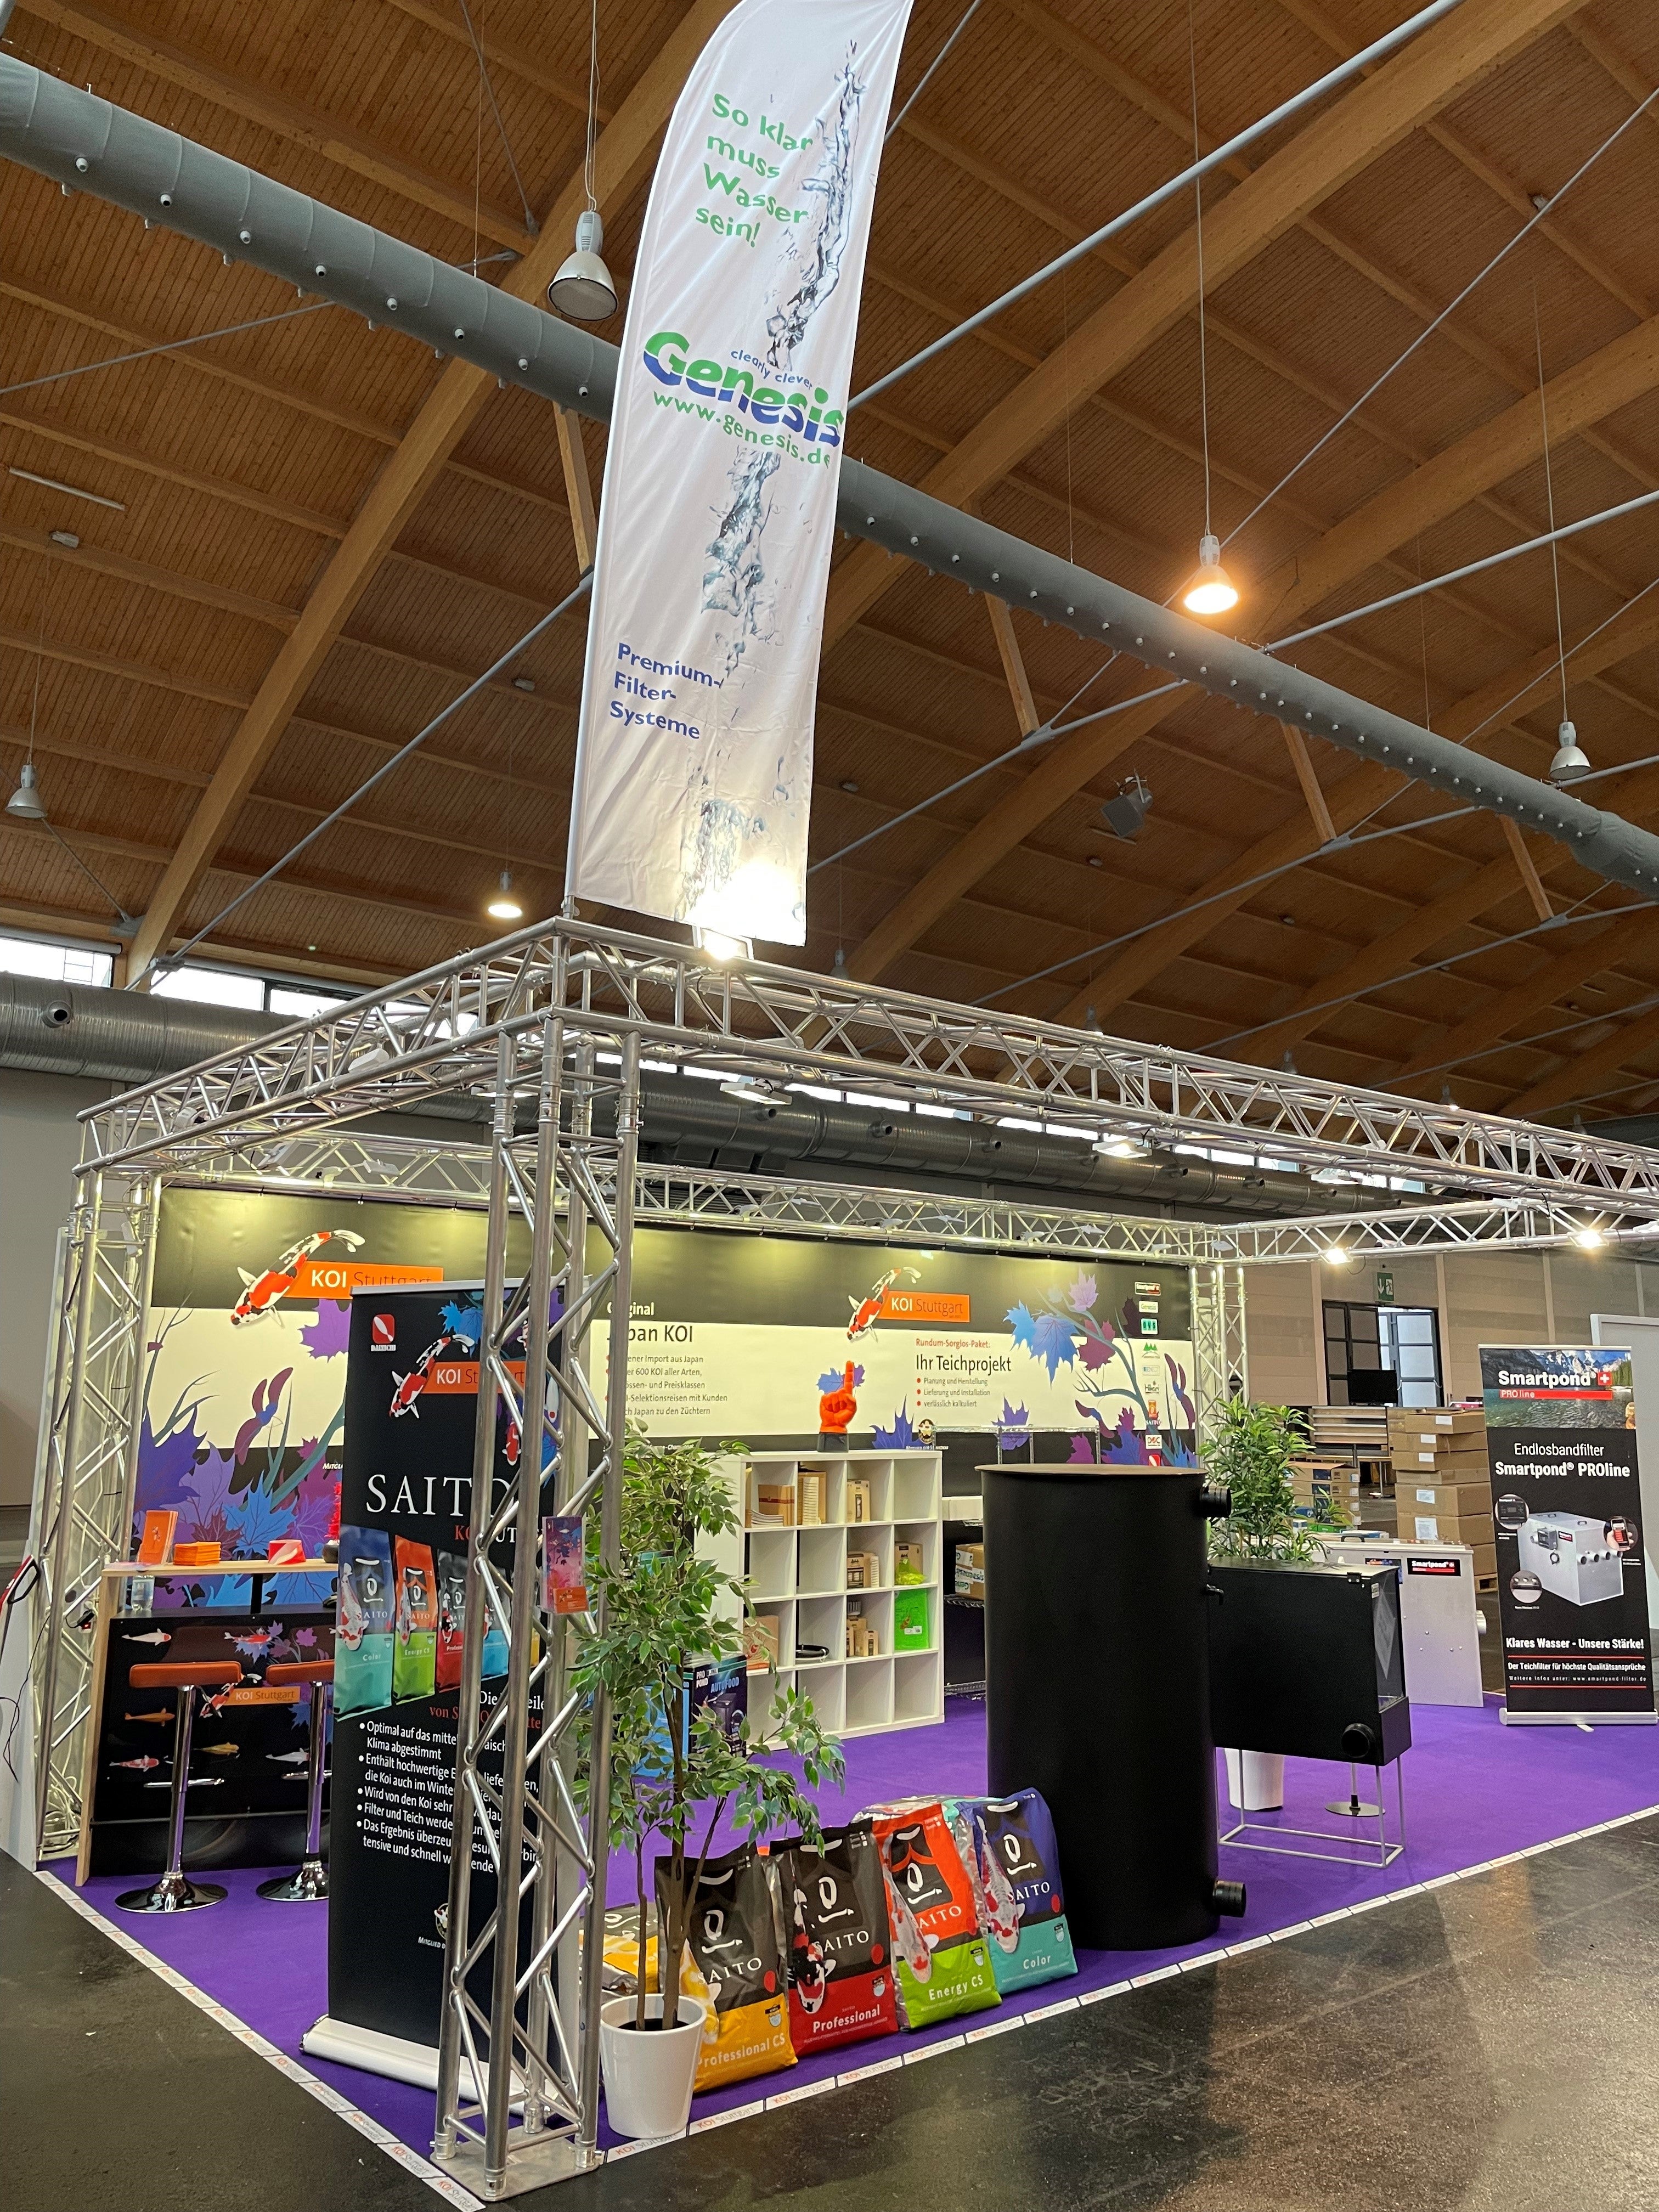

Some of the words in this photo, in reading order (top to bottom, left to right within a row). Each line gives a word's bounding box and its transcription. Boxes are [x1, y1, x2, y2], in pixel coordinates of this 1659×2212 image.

[713, 93, 749, 127] So
[760, 115, 813, 153] klar
[707, 134, 780, 179] muss
[703, 162, 809, 224] Wasser
[696, 206, 760, 248] sein!
[731, 349, 771, 379] clearly
[643, 331, 844, 448] Genesis
[653, 390, 831, 469] www.genesis.de
[613, 671, 676, 701] Filter-
[610, 701, 701, 740] Systeme
[311, 1269, 347, 1288] KOI
[891, 1297, 912, 1311] KOI
[916, 1299, 963, 1317] Stuttgart
[664, 1325, 693, 1342] KOI
[916, 1338, 991, 1350] Rundum-Sorglos-Paket:
[645, 1355, 669, 1364] Import
[684, 1356, 703, 1365] Japan
[916, 1354, 933, 1370] Ihr
[936, 1355, 1012, 1376] Teichprojekt
[437, 1369, 461, 1385] KOI
[664, 1367, 680, 1376] aller
[681, 1368, 702, 1377] Arten,
[664, 1381, 706, 1389] Preisklassen
[924, 1377, 946, 1386] Planung
[958, 1378, 988, 1387] Herstellung
[689, 1393, 701, 1402] mit
[702, 1393, 728, 1402] Kunden
[924, 1389, 949, 1398] Lieferung
[923, 1400, 951, 1408] verlässlich
[952, 1400, 977, 1408] kalkuliert
[634, 1407, 654, 1418] Japan
[665, 1407, 679, 1415] den
[680, 1407, 711, 1415] Züchtern
[1514, 1443, 1605, 1457] Endlosbandfilter
[1578, 1463, 1630, 1477] PROline
[1505, 1637, 1536, 1649] Klares
[1536, 1638, 1570, 1649] Wasser
[1578, 1638, 1611, 1649] Unsere
[1612, 1638, 1645, 1649] Stärke!
[363, 1653, 381, 1662] Color
[404, 1648, 422, 1656] Energy
[1520, 1662, 1551, 1671] Teichfilter
[1551, 1662, 1561, 1671] für
[1562, 1662, 1587, 1671] höchste
[1587, 1663, 1646, 1672] Qualitätsansprüche
[710, 1677, 740, 1693] AUTOFOOD
[235, 1691, 253, 1700] KOI
[256, 1691, 295, 1701] Stuttgart
[429, 1706, 449, 1718] von
[367, 1720, 399, 1736] Optimal
[400, 1726, 415, 1739] auf
[415, 1730, 431, 1742] das
[367, 1737, 390, 1751] Klima
[391, 1741, 442, 1760] abgestimmt
[365, 1753, 395, 1769] Enthält
[396, 1758, 449, 1780] hochwertige
[365, 1770, 379, 1782] die
[379, 1772, 392, 1785] Koi
[393, 1776, 413, 1789] auch
[414, 1779, 426, 1792] im
[427, 1781, 454, 1796] Winte
[364, 1785, 384, 1799] Wird
[385, 1791, 399, 1803] von
[400, 1793, 417, 1806] den
[419, 1797, 432, 1809] Koi
[433, 1799, 453, 1813] sehr
[364, 1802, 384, 1816] Filter
[386, 1806, 401, 1820] und
[403, 1809, 424, 1825] Teich
[425, 1814, 453, 1830] werde
[363, 1819, 379, 1832] Das
[380, 1822, 415, 1839] Ergebnis
[363, 1836, 392, 1852] tensive
[393, 1842, 409, 1856] und
[410, 1846, 442, 1863] schnell
[913, 1905, 962, 1929] AITO
[1023, 1955, 1051, 1970] Color
[697, 1957, 763, 1985] SAITO
[928, 1981, 968, 2001] Energy
[971, 1974, 984, 1988] CS
[812, 2004, 881, 2033] Professional
[772, 2032, 786, 2047] CS
[772, 2095, 790, 2104] KOI
[697, 2118, 716, 2129] KOI
[615, 2145, 635, 2155] KOI
[437, 2180, 454, 2192] KOI
